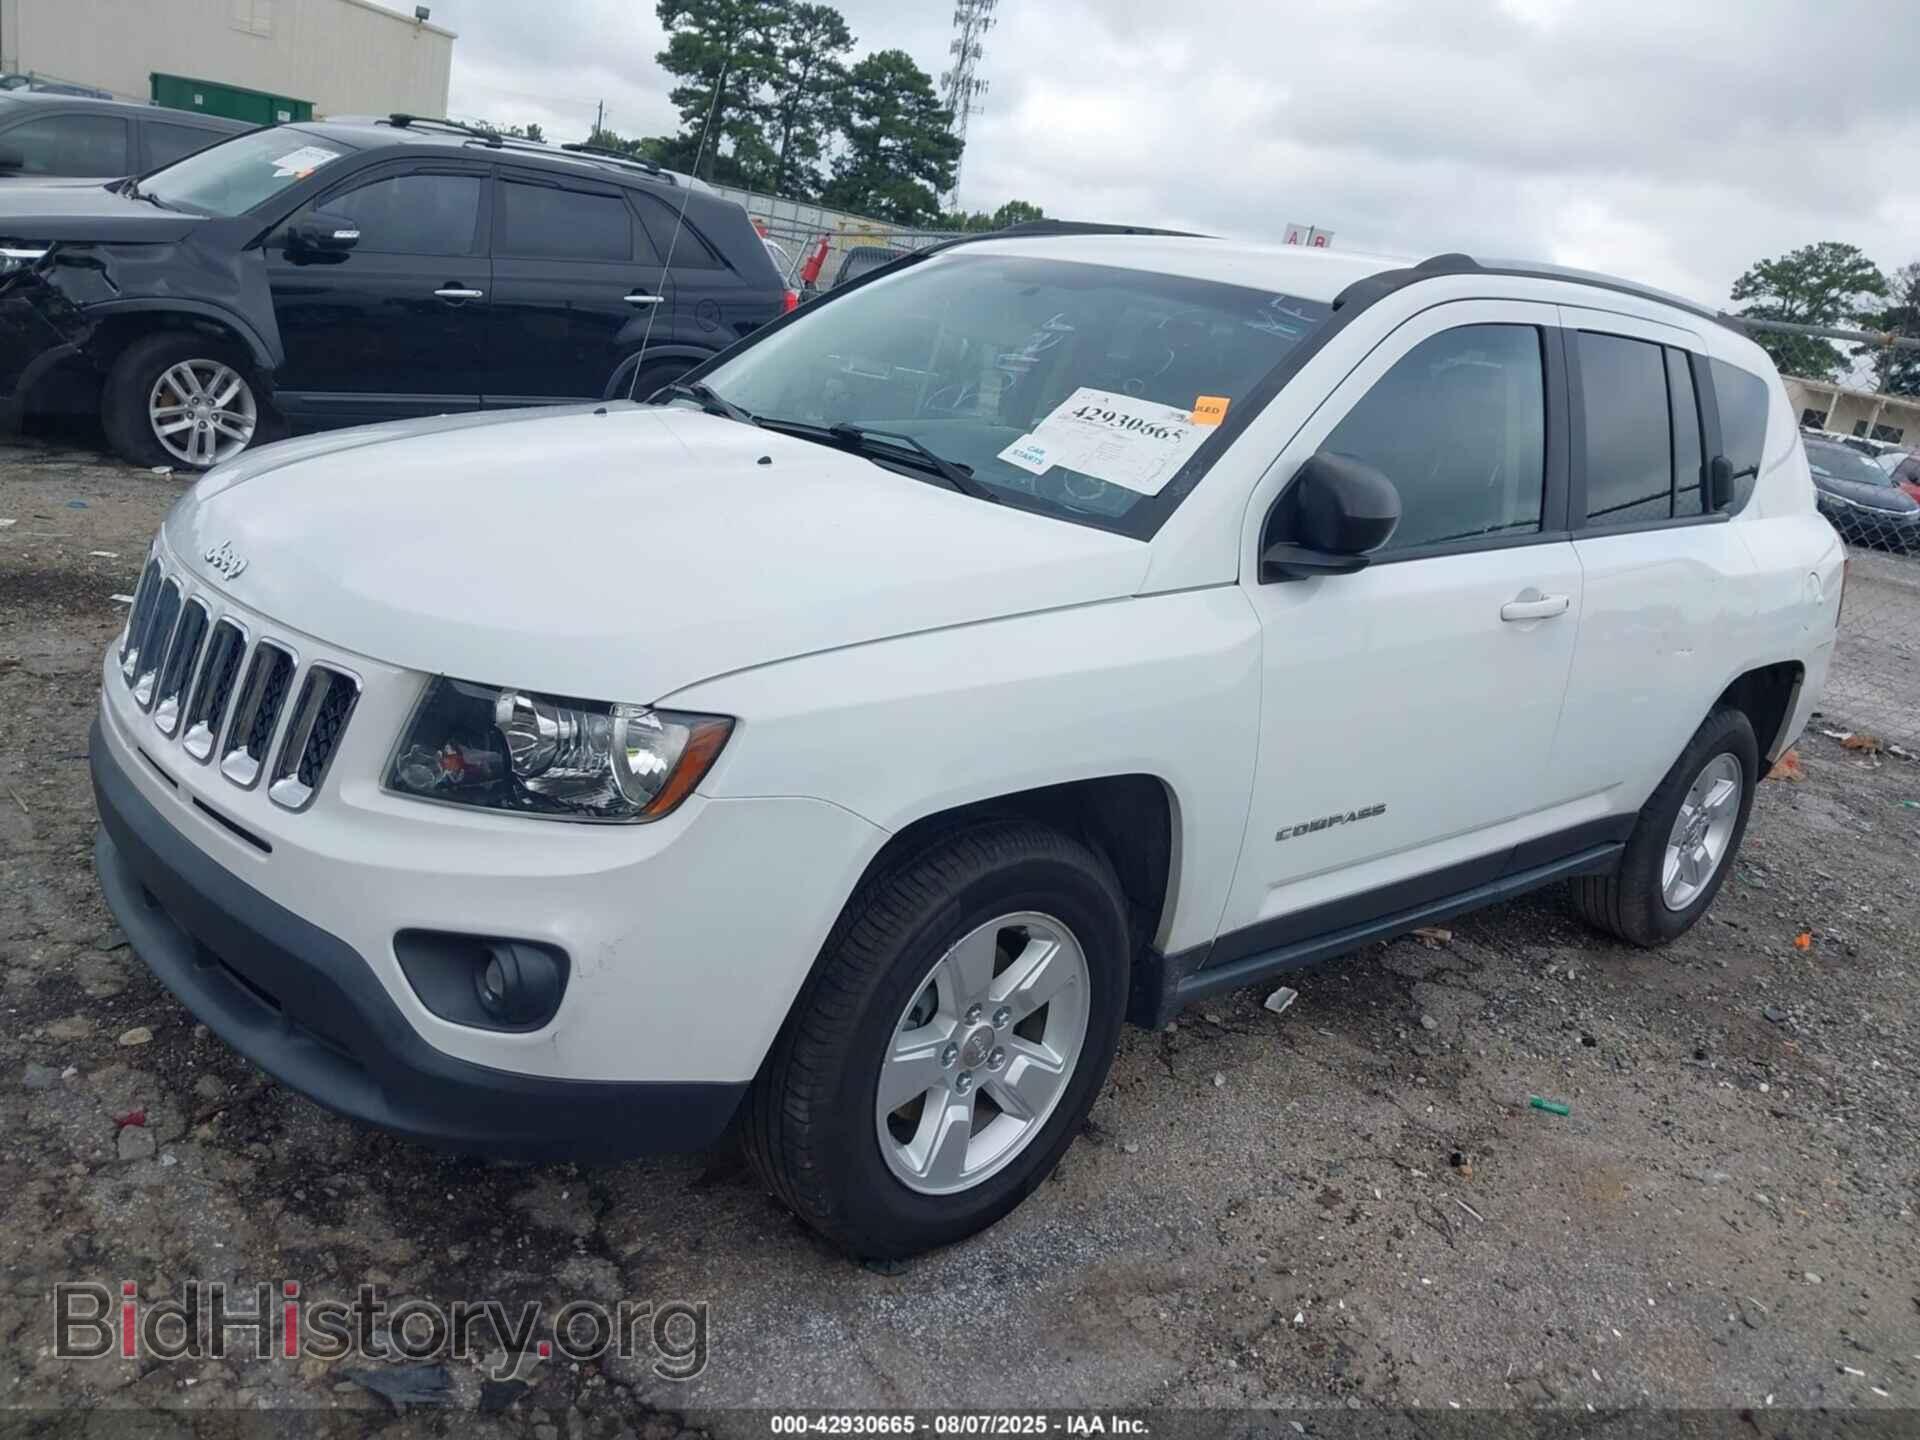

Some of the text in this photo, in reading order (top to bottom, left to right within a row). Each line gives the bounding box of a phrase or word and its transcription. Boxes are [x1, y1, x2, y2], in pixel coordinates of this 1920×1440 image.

[1288, 231, 1297, 245] A
[204, 540, 249, 581] Jeep
[1275, 803, 1386, 841] COMPASS
